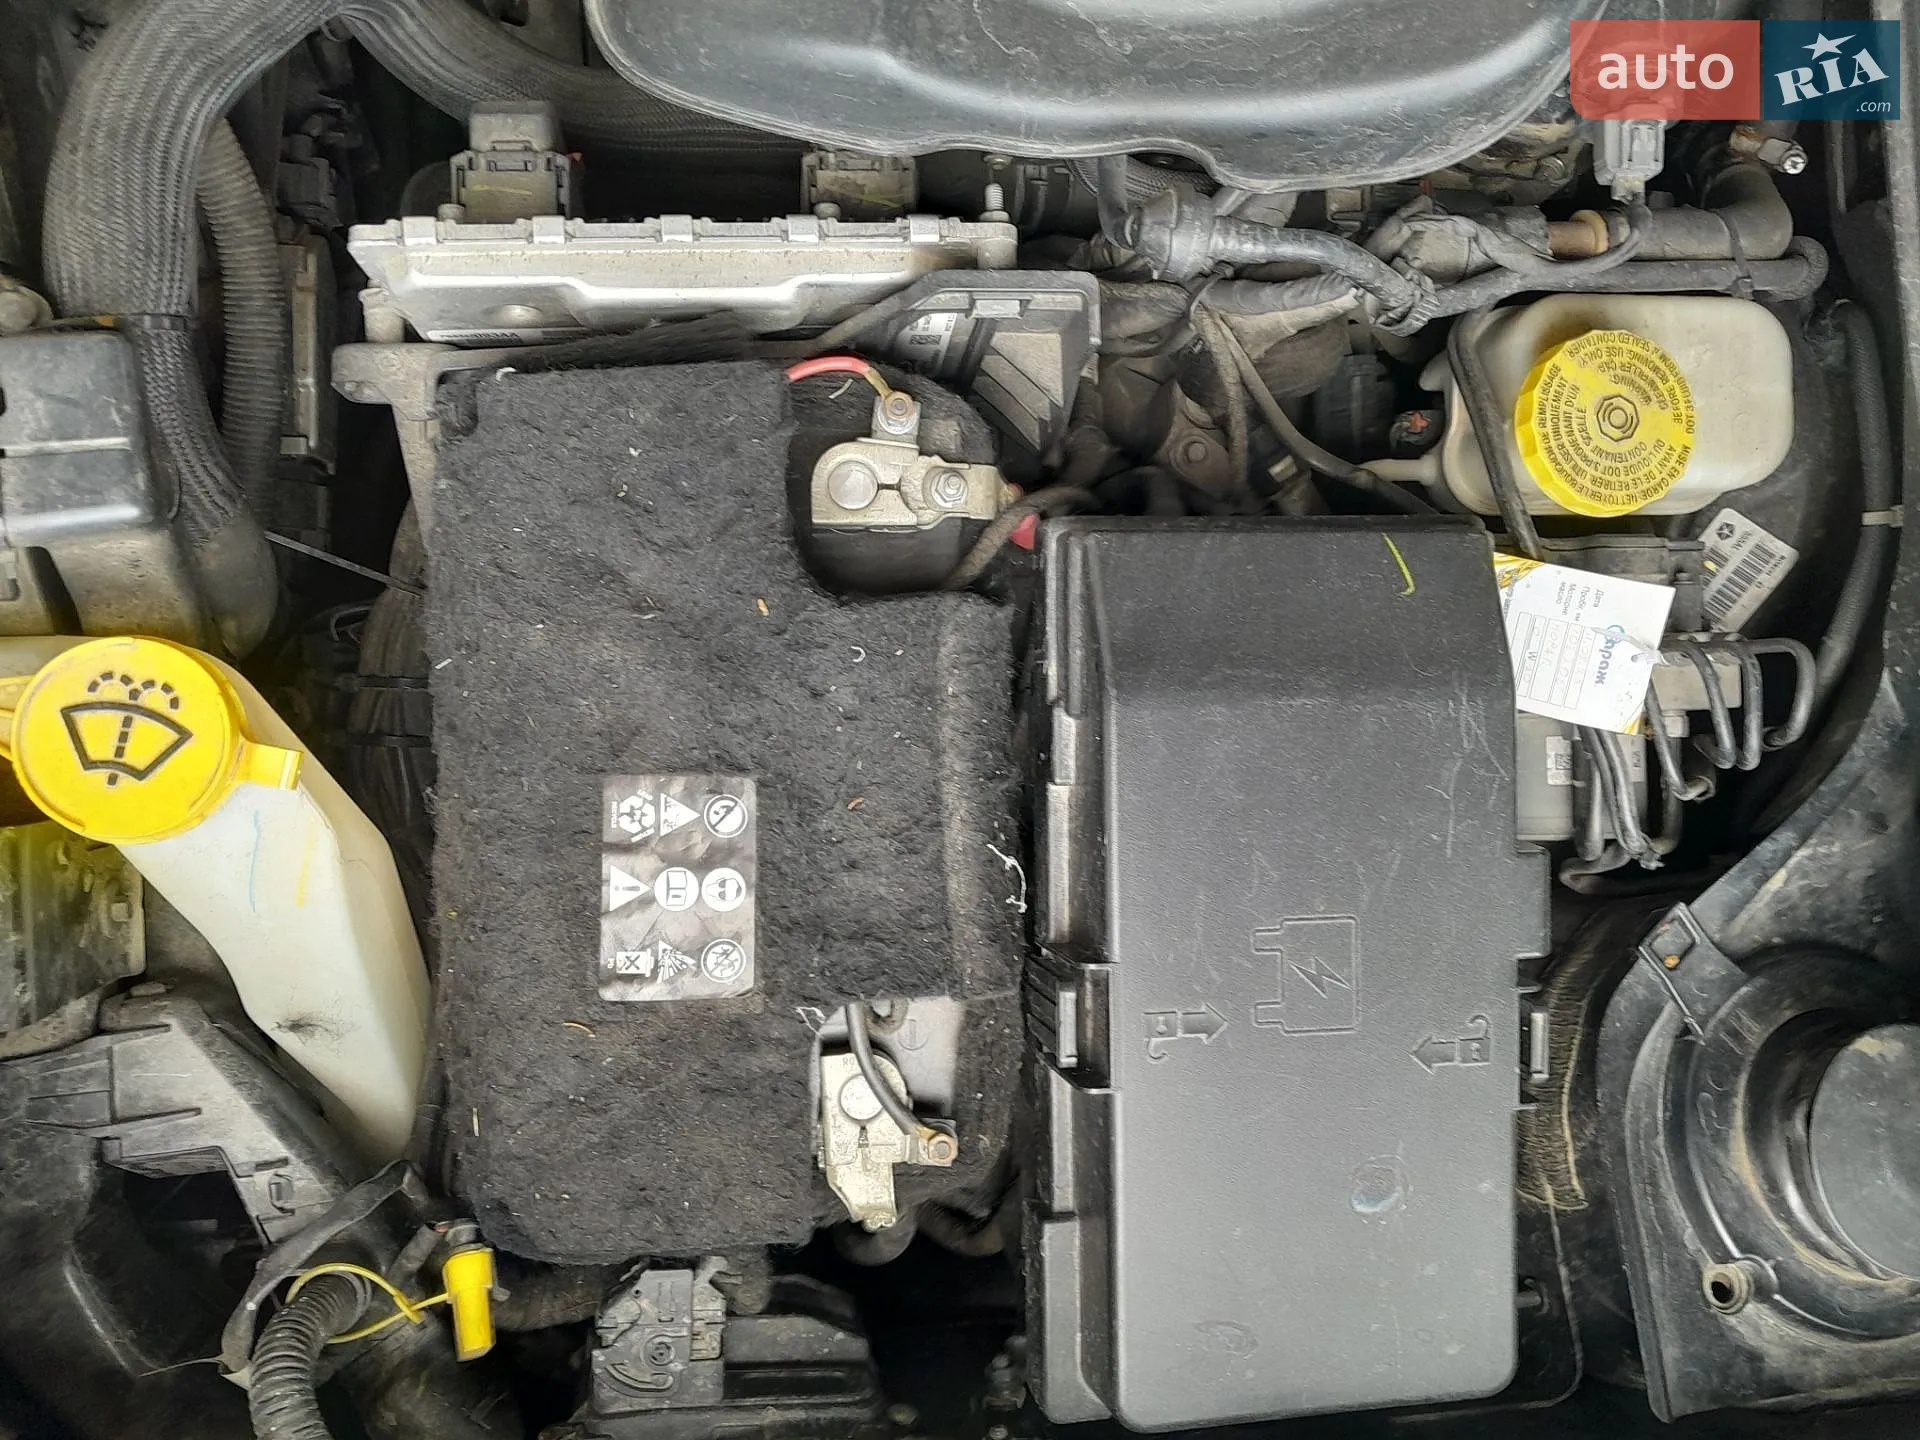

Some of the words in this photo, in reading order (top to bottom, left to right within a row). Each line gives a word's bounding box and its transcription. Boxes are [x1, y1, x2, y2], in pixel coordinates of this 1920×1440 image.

[1566, 332, 1615, 359] CONTAINER
[1605, 346, 1624, 358] USE
[1617, 331, 1652, 352] SEALED
[1579, 347, 1603, 367] ONLY
[1598, 360, 1616, 374] CAP
[1657, 350, 1681, 378] FROM
[1536, 362, 1562, 429] REMPLISSAGE
[1563, 382, 1581, 408] D'UN
[1645, 377, 1669, 410] CLEAN
[1668, 383, 1683, 423] BEFORE
[1548, 375, 1570, 442] UNIQUEMENT
[1684, 403, 1694, 412] 3
[1685, 413, 1695, 435] DOT
[1539, 430, 1551, 445] DE
[1562, 410, 1594, 467] PROVENANT
[1651, 438, 1666, 455] DU
[1555, 441, 1588, 480] UTILISER
[1592, 440, 1649, 461] CONTENANT
[1656, 444, 1677, 475] AVANT
[1677, 444, 1692, 468] MISE
[1542, 444, 1578, 489] BOUCHON
[1592, 460, 1601, 472] 3
[1601, 464, 1620, 477] DOT
[1621, 450, 1658, 476] LIQUIDE
[1666, 465, 1681, 481] EN
[1629, 475, 1643, 489] LE
[1641, 469, 1657, 484] DE
[1573, 482, 1590, 498] LE
[1588, 490, 1638, 505] NETTOYER
[1556, 581, 1567, 605] масло
[1562, 583, 1577, 616] Моторне
[1593, 588, 1605, 608] Дата
